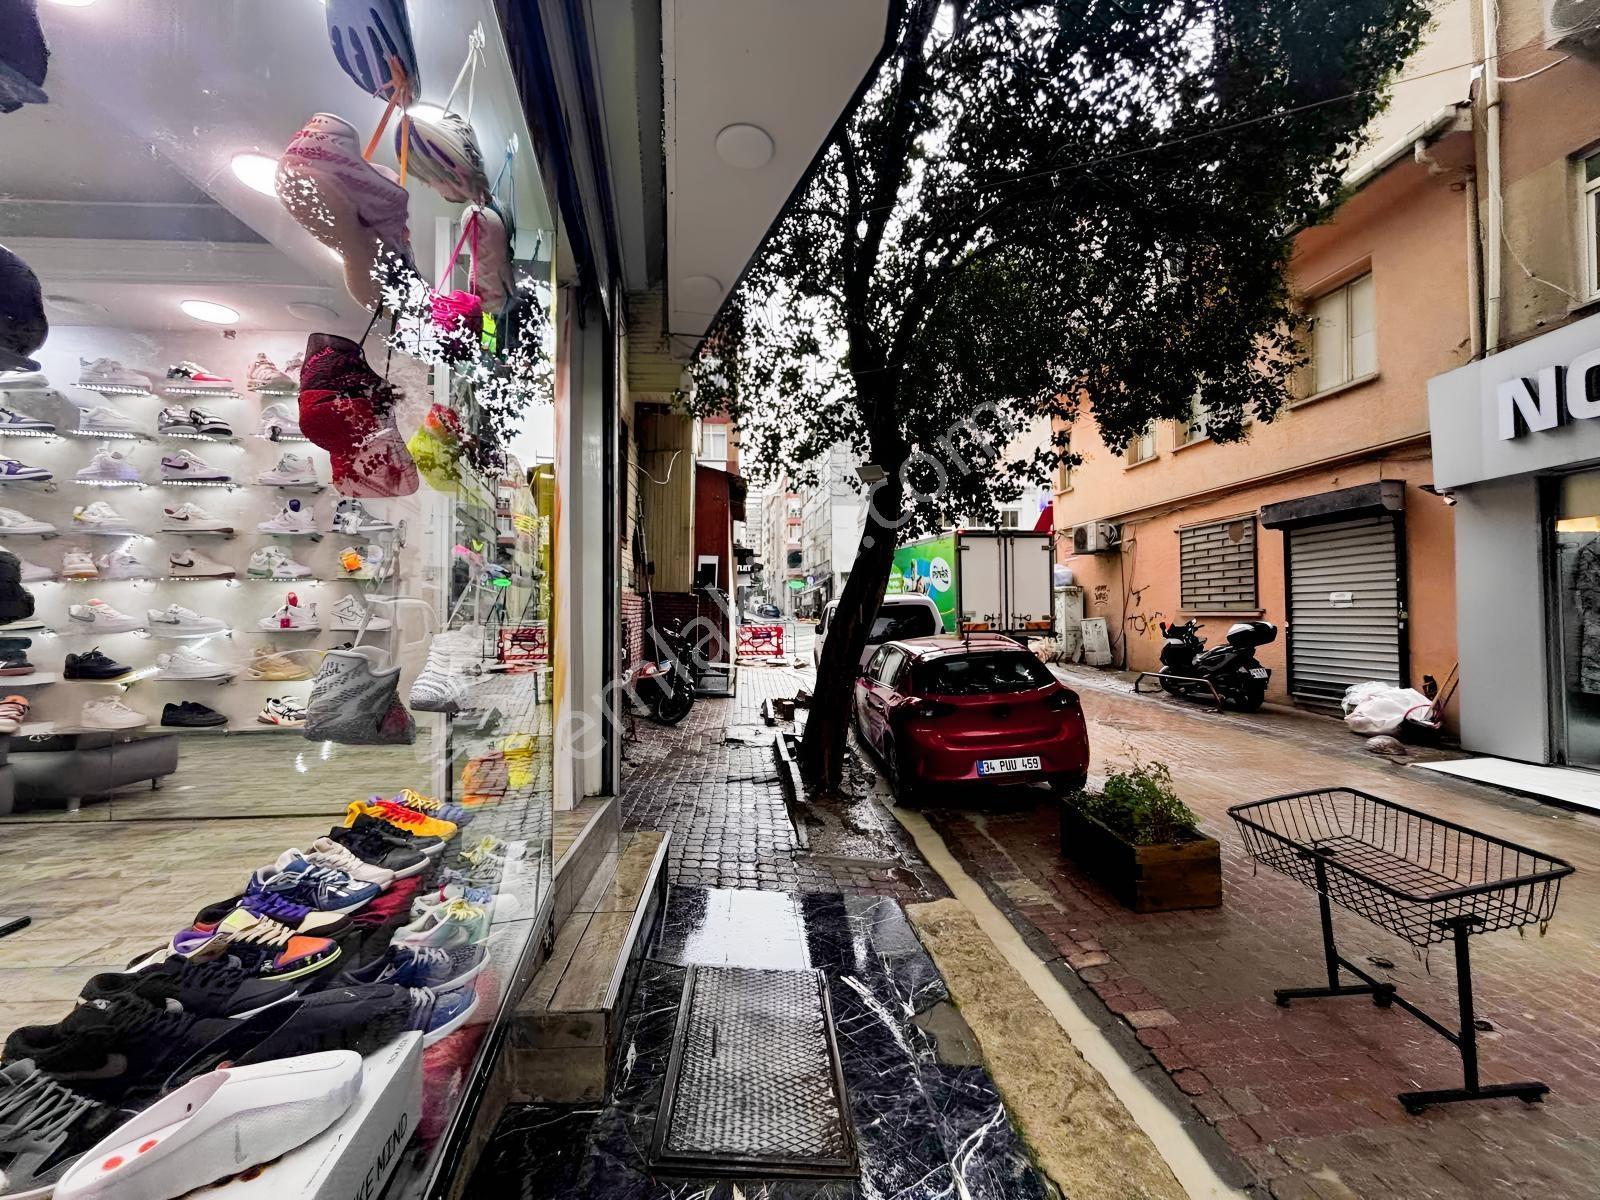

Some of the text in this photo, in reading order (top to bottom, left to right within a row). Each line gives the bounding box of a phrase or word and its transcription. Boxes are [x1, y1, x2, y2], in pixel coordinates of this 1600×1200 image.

[983, 758, 1039, 773] 34 PUU 459
[377, 1112, 408, 1181] MIND
